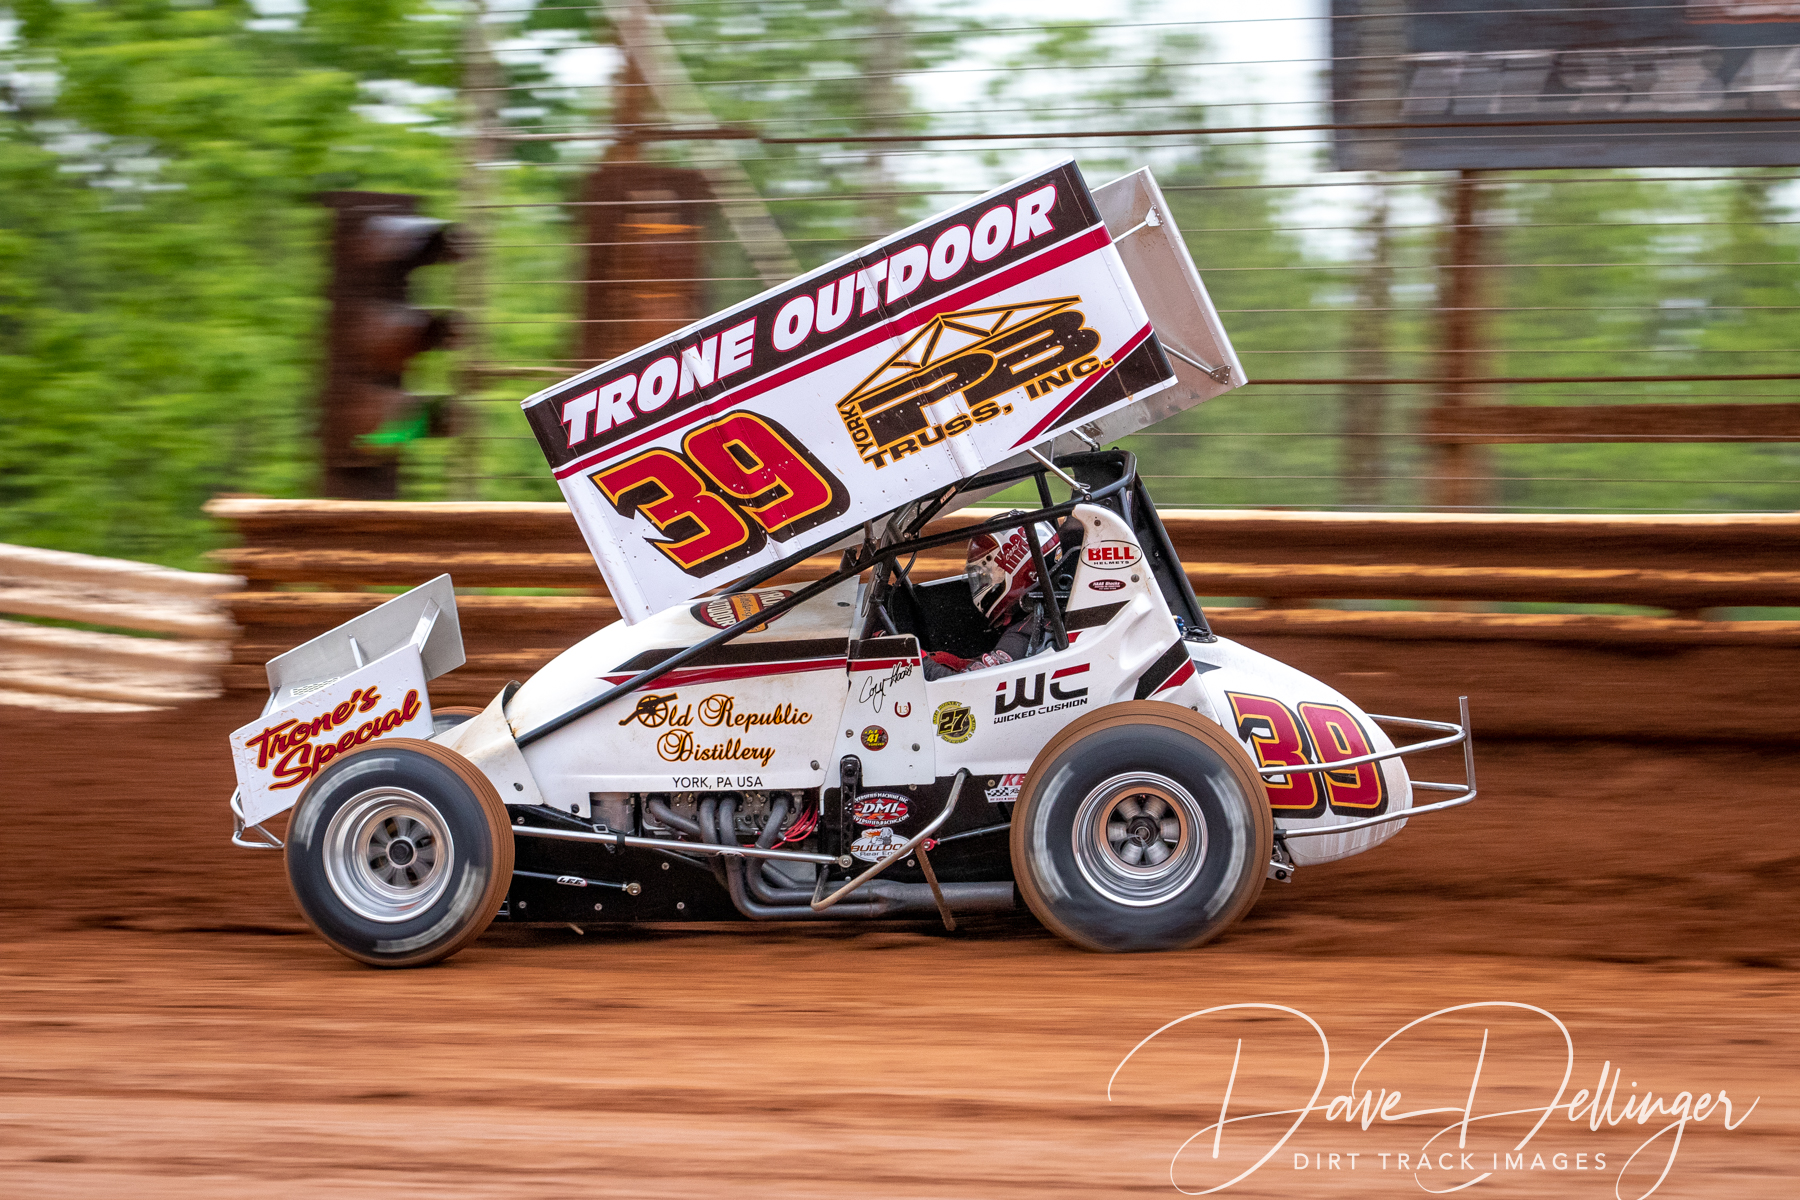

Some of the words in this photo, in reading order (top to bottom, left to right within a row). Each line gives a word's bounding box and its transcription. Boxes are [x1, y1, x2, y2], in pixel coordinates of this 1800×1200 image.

[561, 317, 758, 449] TRONE
[771, 184, 1058, 353] OUTDOOR
[841, 403, 869, 457] YORK
[862, 400, 1014, 470] TRUSS,
[1023, 355, 1115, 402] INC.
[587, 409, 851, 578] 39
[1088, 546, 1135, 561] BELL
[244, 684, 382, 769] Trone's
[698, 693, 814, 734] Republic
[938, 707, 970, 735] 27
[993, 709, 1036, 725] WICKED
[1037, 697, 1088, 715] CUSHION
[267, 688, 422, 791] Special
[656, 728, 777, 768] Distillery
[867, 733, 880, 743] 41
[1224, 690, 1388, 819] 39
[672, 777, 713, 789] YORK,
[716, 777, 734, 788] PA
[737, 776, 764, 788] USA
[861, 803, 900, 813] DMI
[851, 843, 904, 853] BULLDO
